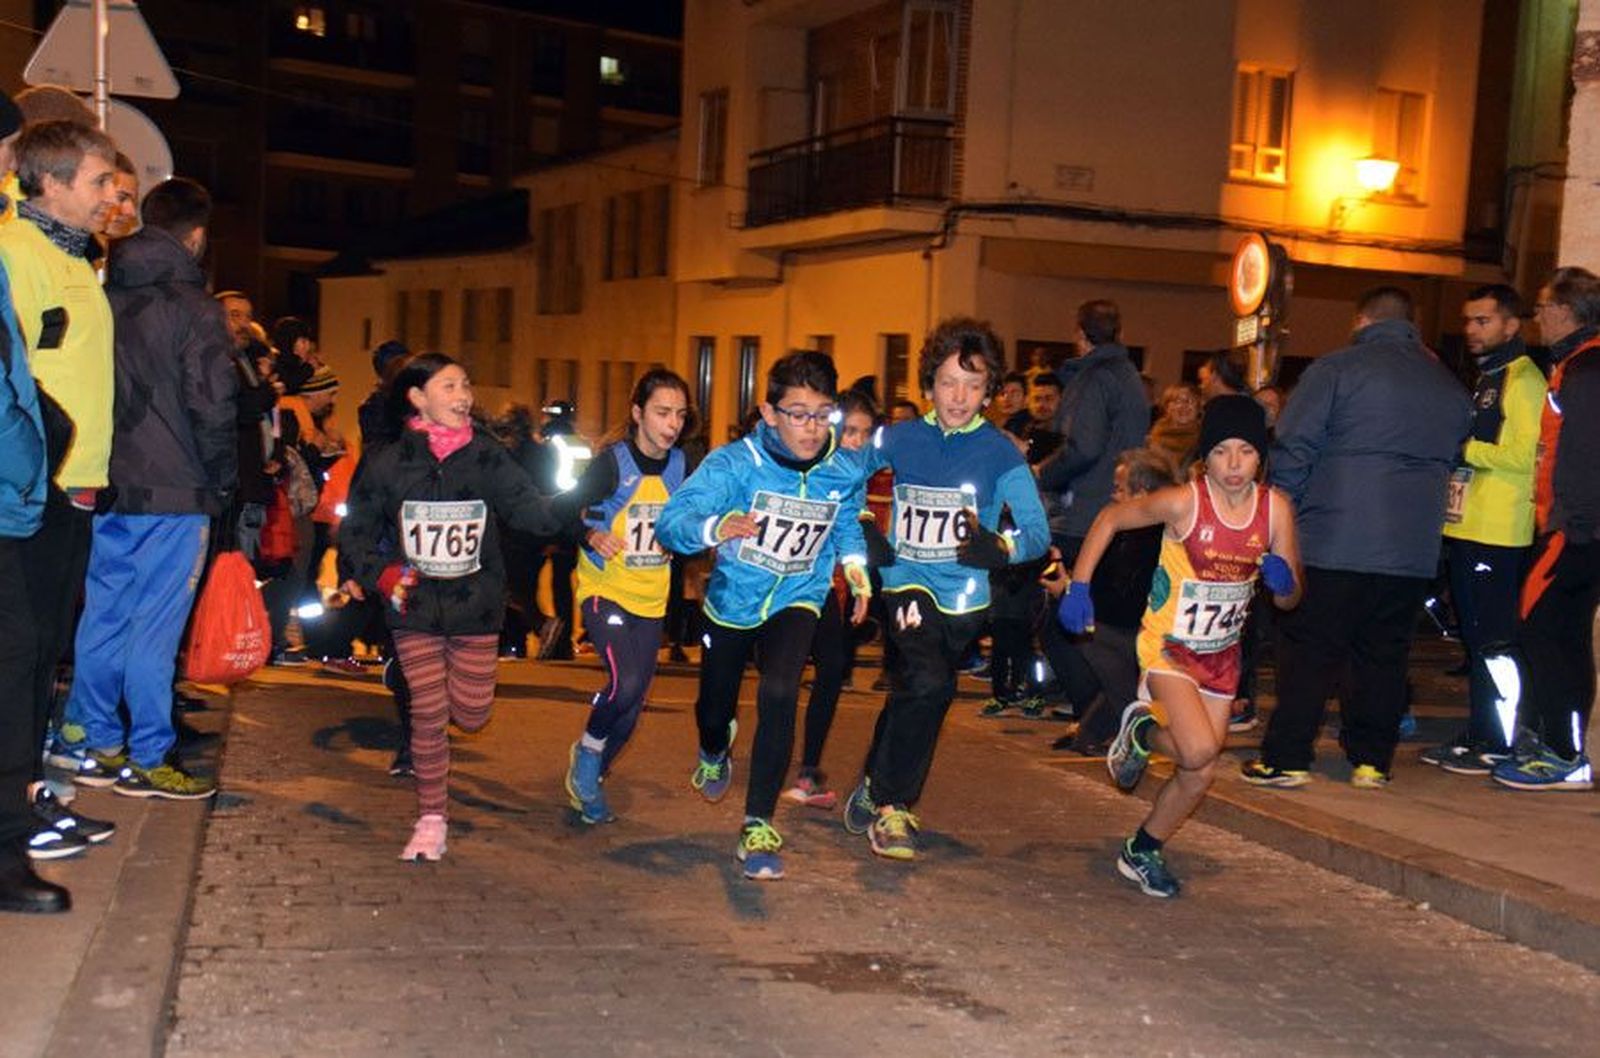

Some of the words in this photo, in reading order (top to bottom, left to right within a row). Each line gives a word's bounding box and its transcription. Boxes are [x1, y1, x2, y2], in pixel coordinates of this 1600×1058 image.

[409, 523, 479, 557] 1765
[631, 521, 656, 551] 17
[756, 515, 828, 556] 1737
[903, 505, 972, 542] 1776
